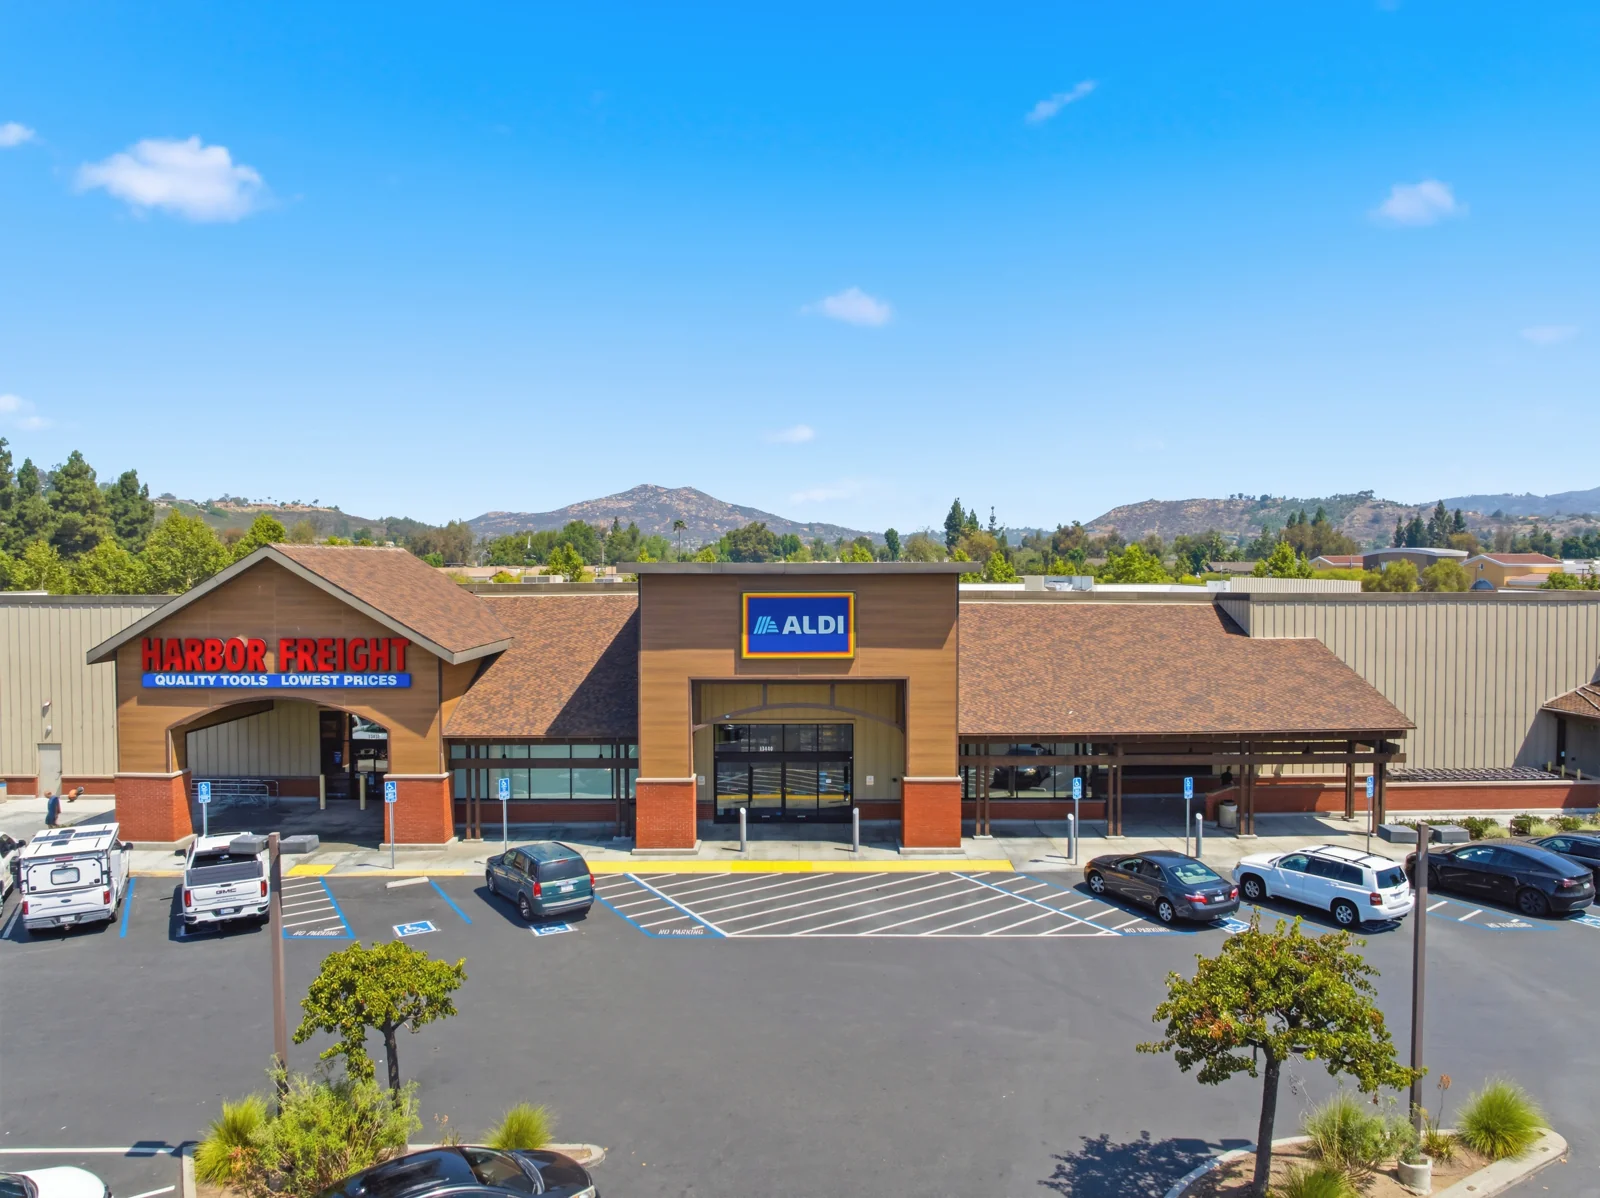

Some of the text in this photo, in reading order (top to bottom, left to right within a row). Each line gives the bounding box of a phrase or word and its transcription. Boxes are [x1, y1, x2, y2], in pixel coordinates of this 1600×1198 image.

[782, 615, 845, 635] ALDI
[141, 637, 410, 672] HARBOR FREIGHT
[155, 675, 397, 686] QUALITY TOOLS LOWEST PRICES
